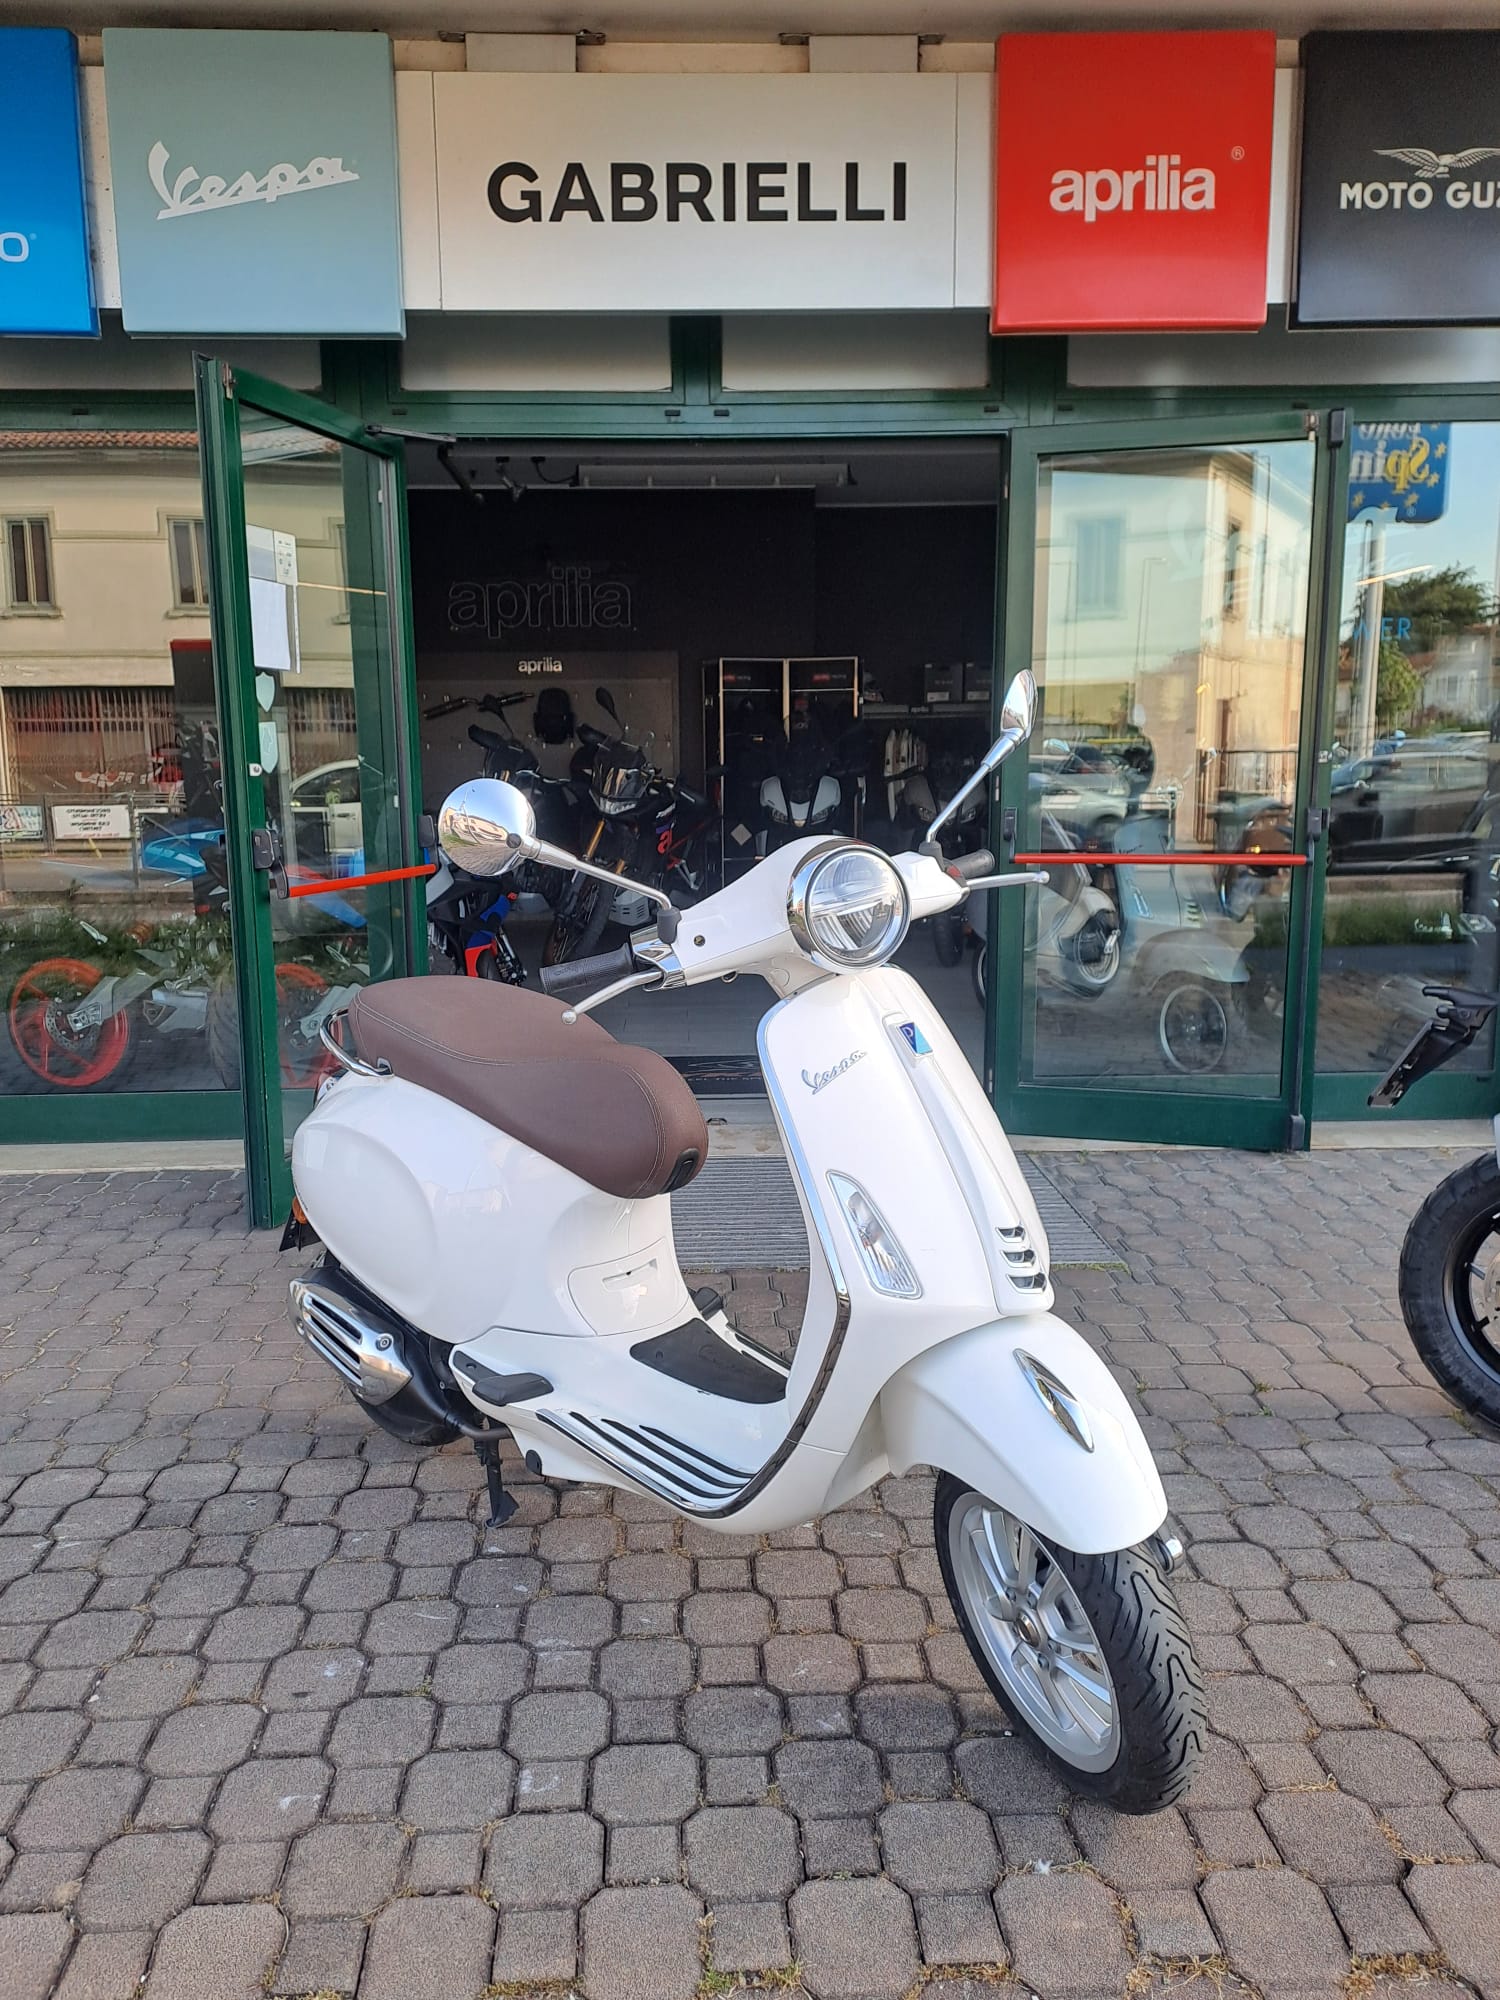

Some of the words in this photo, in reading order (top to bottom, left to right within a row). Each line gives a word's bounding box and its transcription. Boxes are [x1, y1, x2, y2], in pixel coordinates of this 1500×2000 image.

[148, 140, 361, 221] Vespa
[487, 161, 907, 223] GABRIELLI
[1049, 154, 1216, 223] aprilia
[1339, 181, 1433, 210] MOTO
[1445, 181, 1500, 209] GU
[448, 566, 631, 640] aprilia
[518, 656, 563, 675] aprilia
[800, 1049, 868, 1096] Vespa
